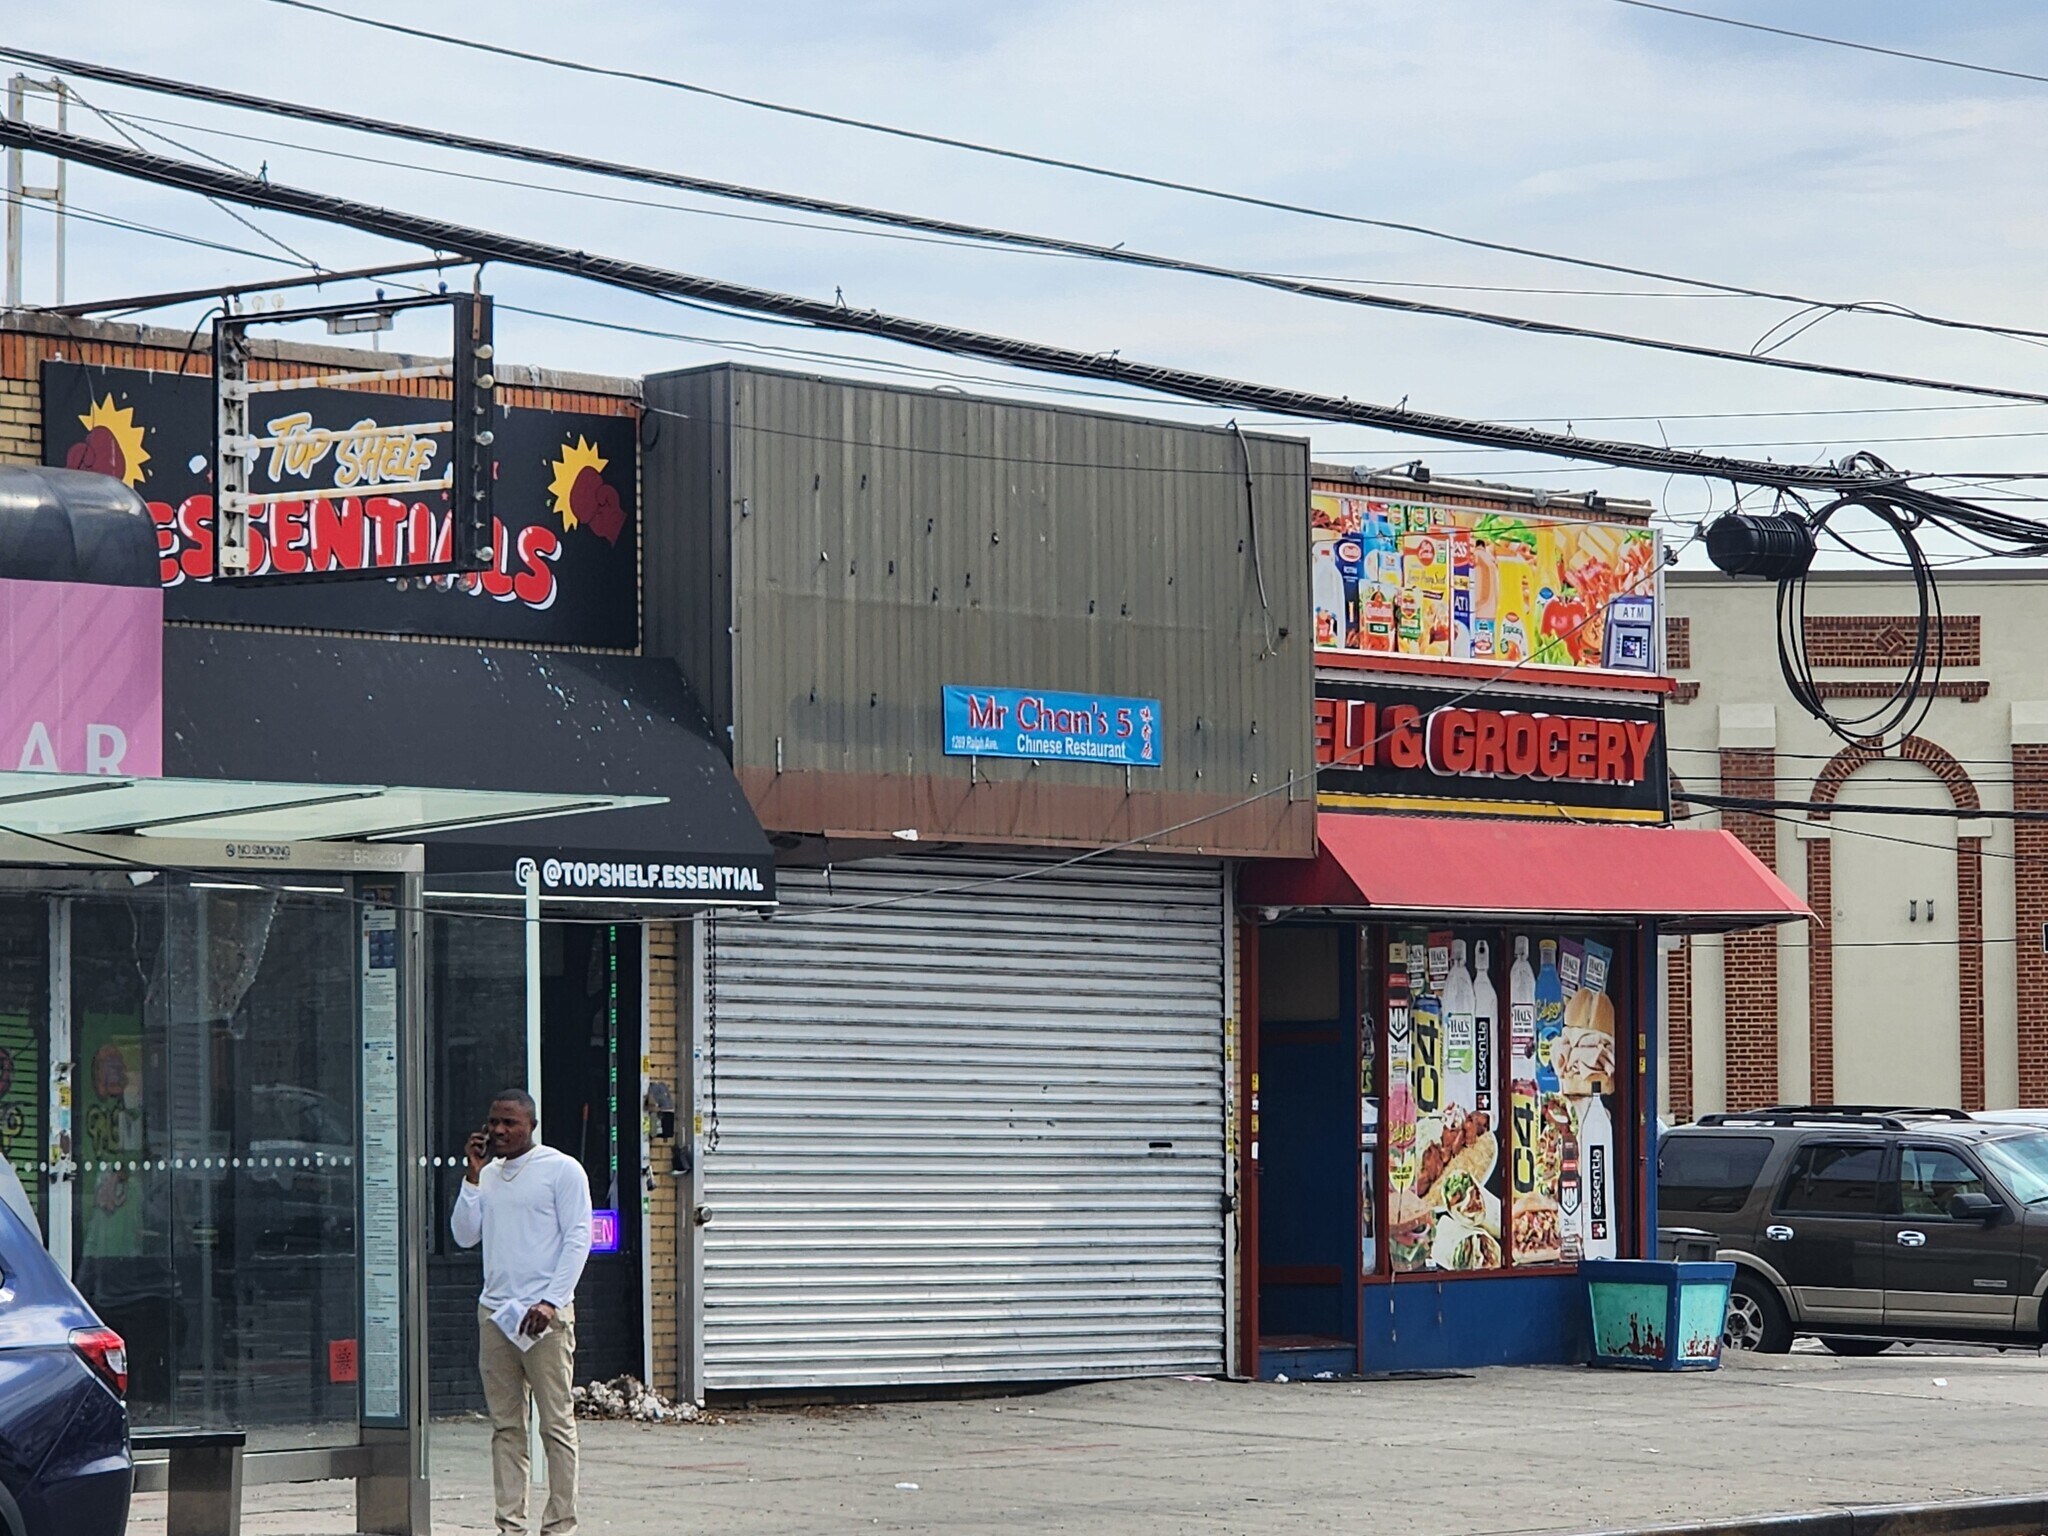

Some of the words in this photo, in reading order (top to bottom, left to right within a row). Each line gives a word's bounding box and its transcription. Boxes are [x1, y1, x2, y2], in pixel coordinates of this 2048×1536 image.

[335, 418, 437, 488] SHELF
[1622, 606, 1645, 618] ATM
[968, 694, 1009, 730] Mr
[1016, 697, 1109, 736] Chan's
[1116, 707, 1134, 739] 5
[1017, 733, 1062, 755] Chinese
[1065, 736, 1126, 758] Restaurant
[1379, 703, 1426, 770] &
[1427, 706, 1657, 786] GROCERY
[237, 844, 250, 855] NO
[251, 844, 290, 856] SMOKING
[542, 858, 764, 891] @TOPSHELF.ESSENTIAL
[1417, 1020, 1439, 1112] C4
[1477, 1020, 1489, 1088] essentia
[1513, 1102, 1535, 1193] C4
[1591, 1148, 1603, 1216] essentia
